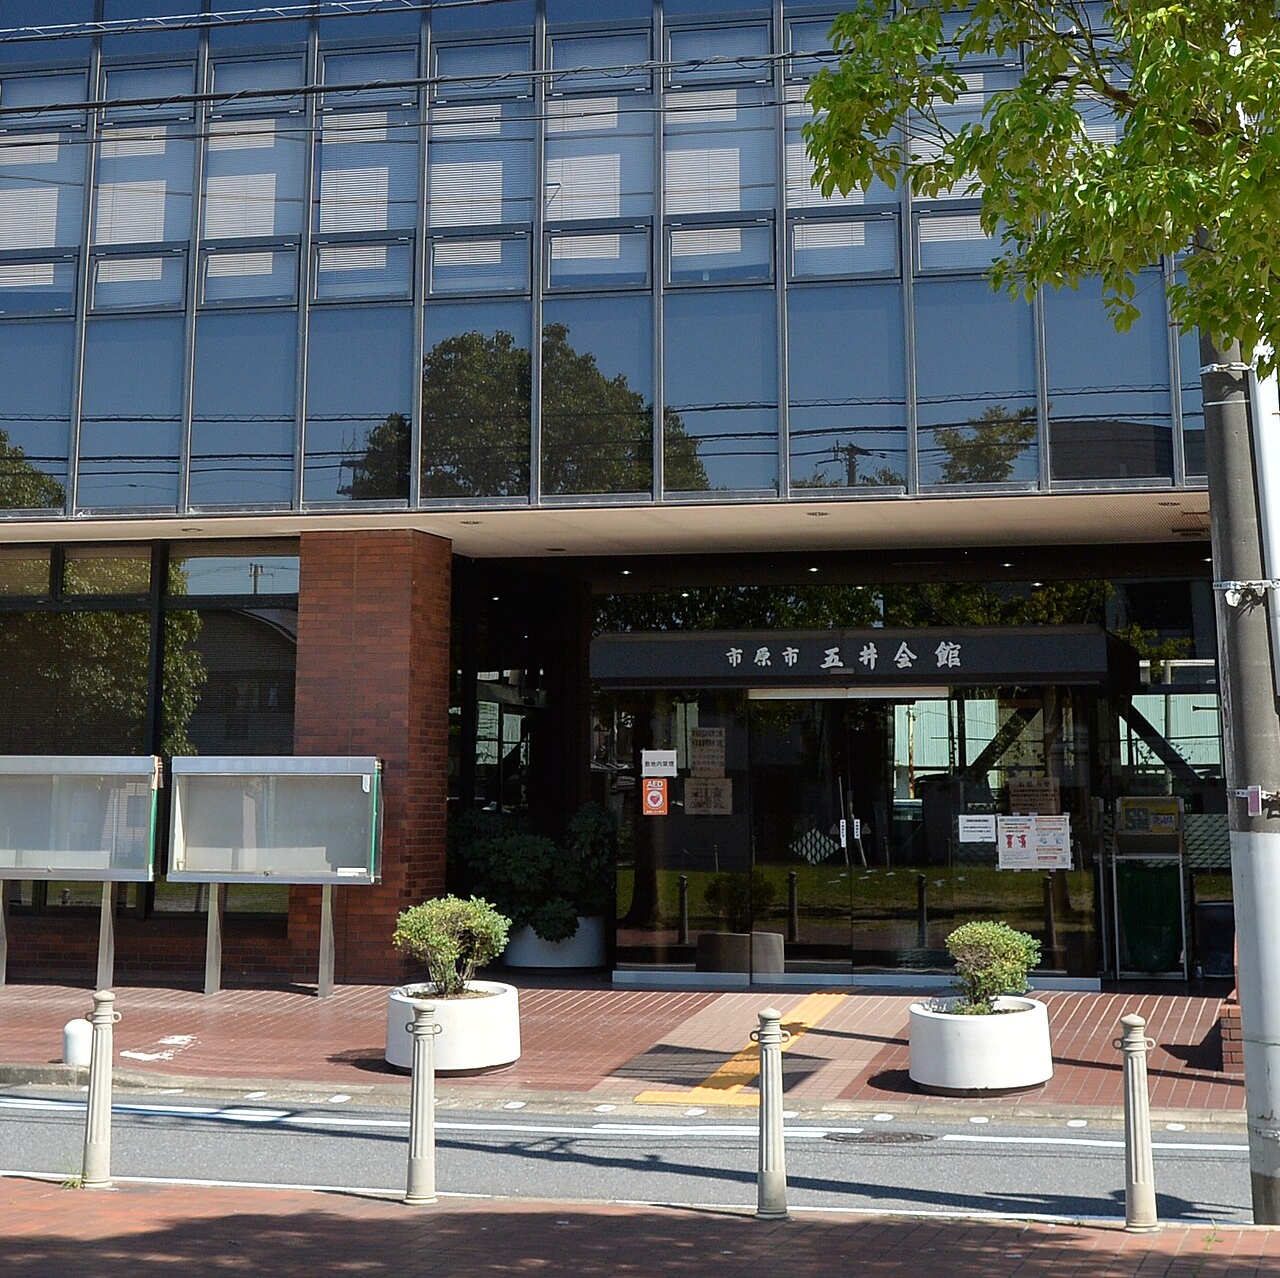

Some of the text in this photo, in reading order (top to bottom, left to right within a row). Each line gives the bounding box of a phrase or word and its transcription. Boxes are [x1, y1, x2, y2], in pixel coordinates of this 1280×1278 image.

[726, 641, 962, 670] 市原市 五井会館
[647, 780, 663, 788] AED
